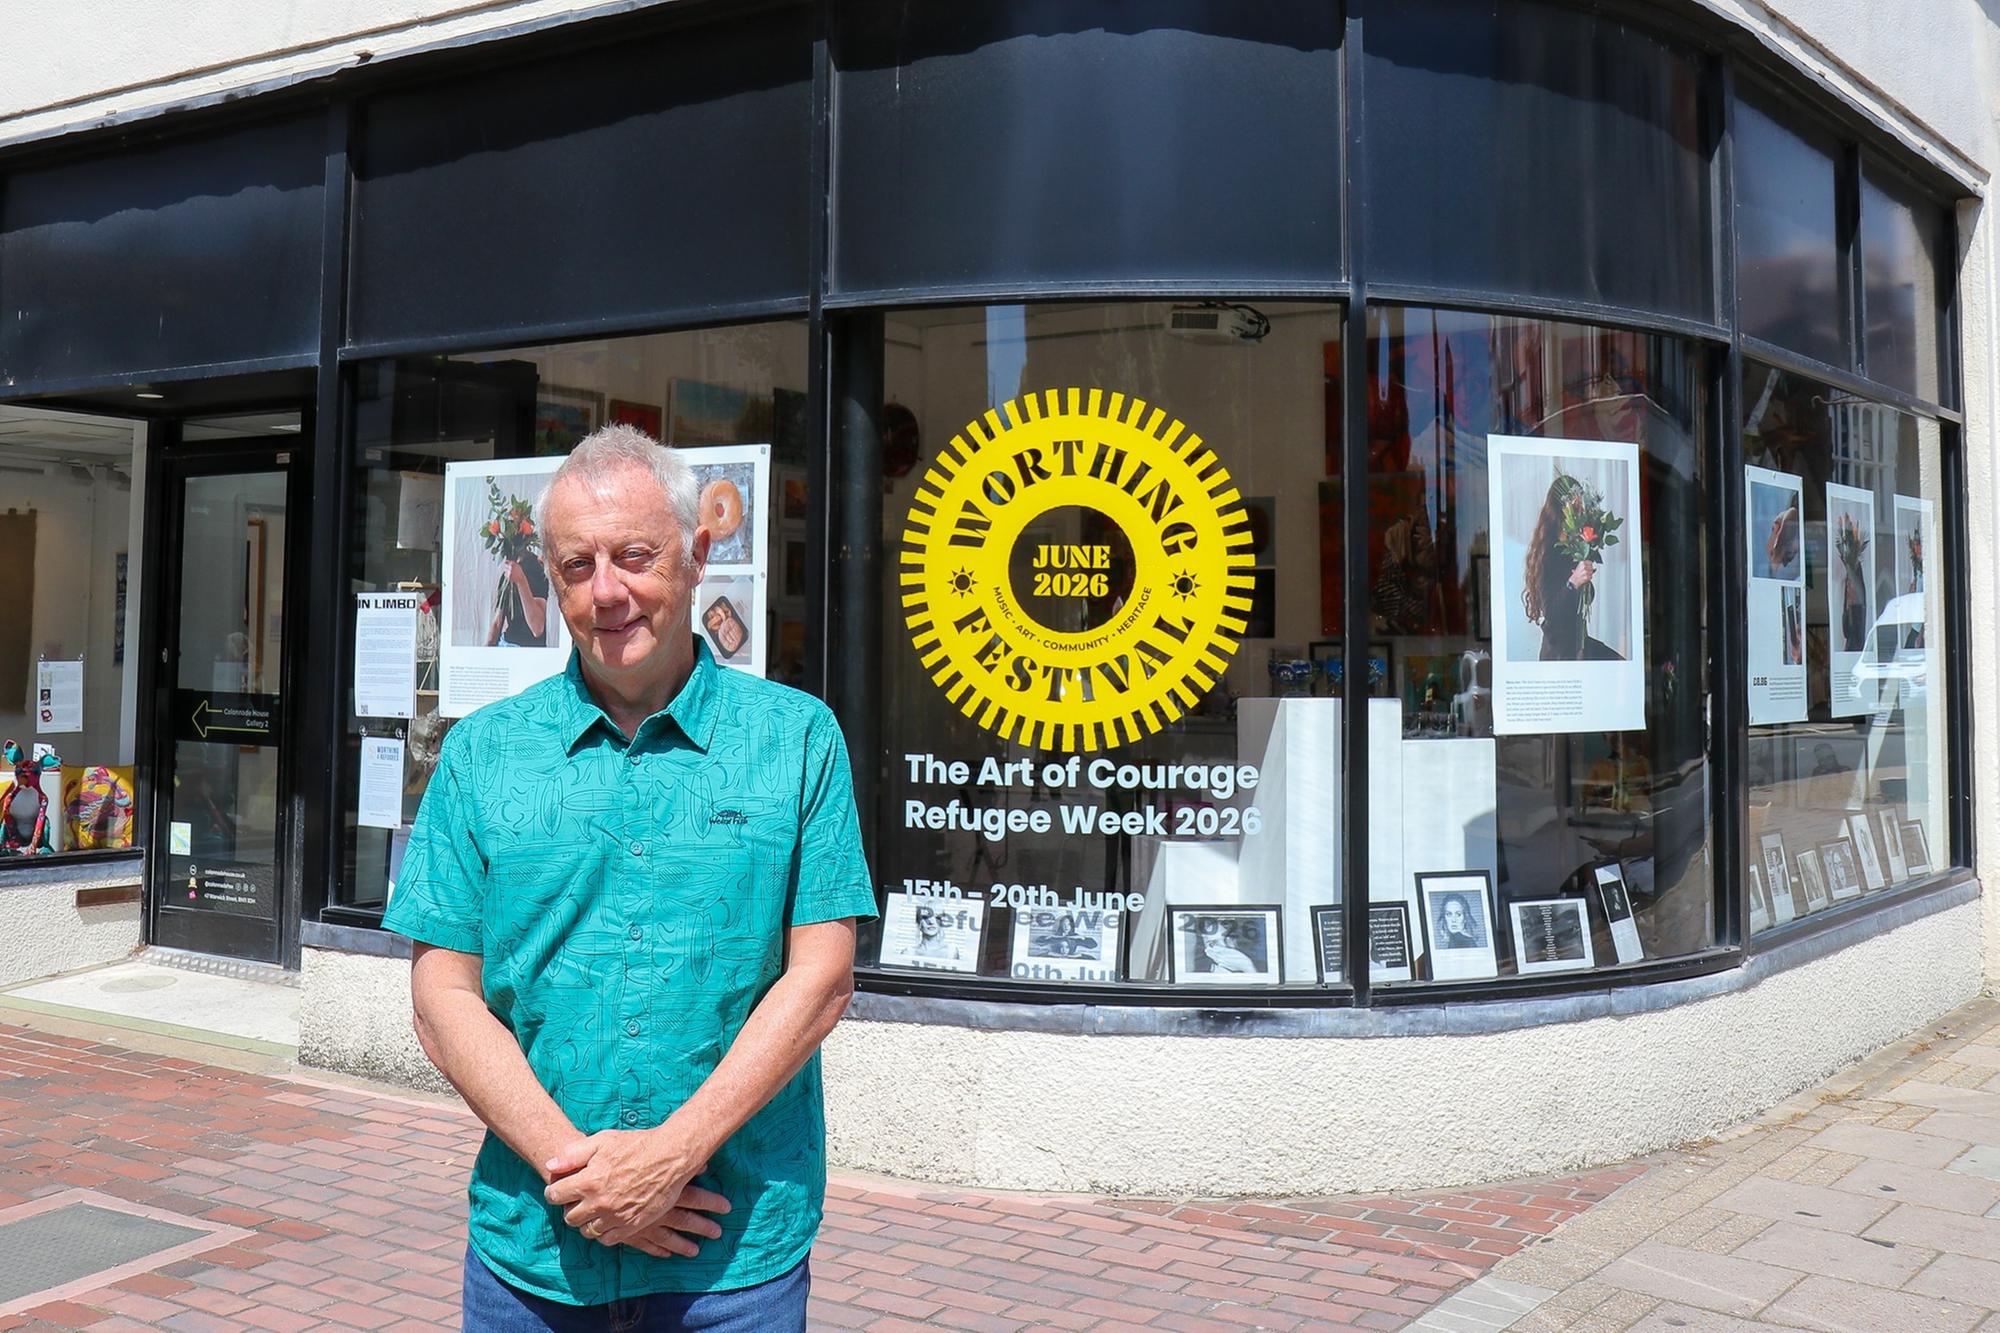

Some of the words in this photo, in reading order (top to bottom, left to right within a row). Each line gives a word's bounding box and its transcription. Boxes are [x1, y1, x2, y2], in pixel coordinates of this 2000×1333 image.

[949, 440, 1198, 557] WORTHING
[1033, 545, 1110, 569] JUNE
[358, 599, 370, 609] IN
[375, 599, 416, 609] LIMBO
[1033, 573, 1109, 597] 2026
[993, 586, 1013, 620] MUSIC
[1015, 624, 1036, 641] ART
[1043, 635, 1111, 652] COMMUNITY
[1116, 586, 1152, 635] HERITAGE
[953, 606, 1195, 702] FESTIVAL
[905, 753, 969, 785] The
[976, 757, 1034, 788] Art
[1042, 756, 1080, 788] of
[1088, 758, 1260, 800] Courage
[904, 800, 1051, 842] Refugee
[1060, 805, 1168, 835] Week
[1175, 806, 1263, 836] 2026
[903, 879, 962, 905] 15th
[990, 883, 1059, 909] 20th
[1066, 886, 1145, 912] June
